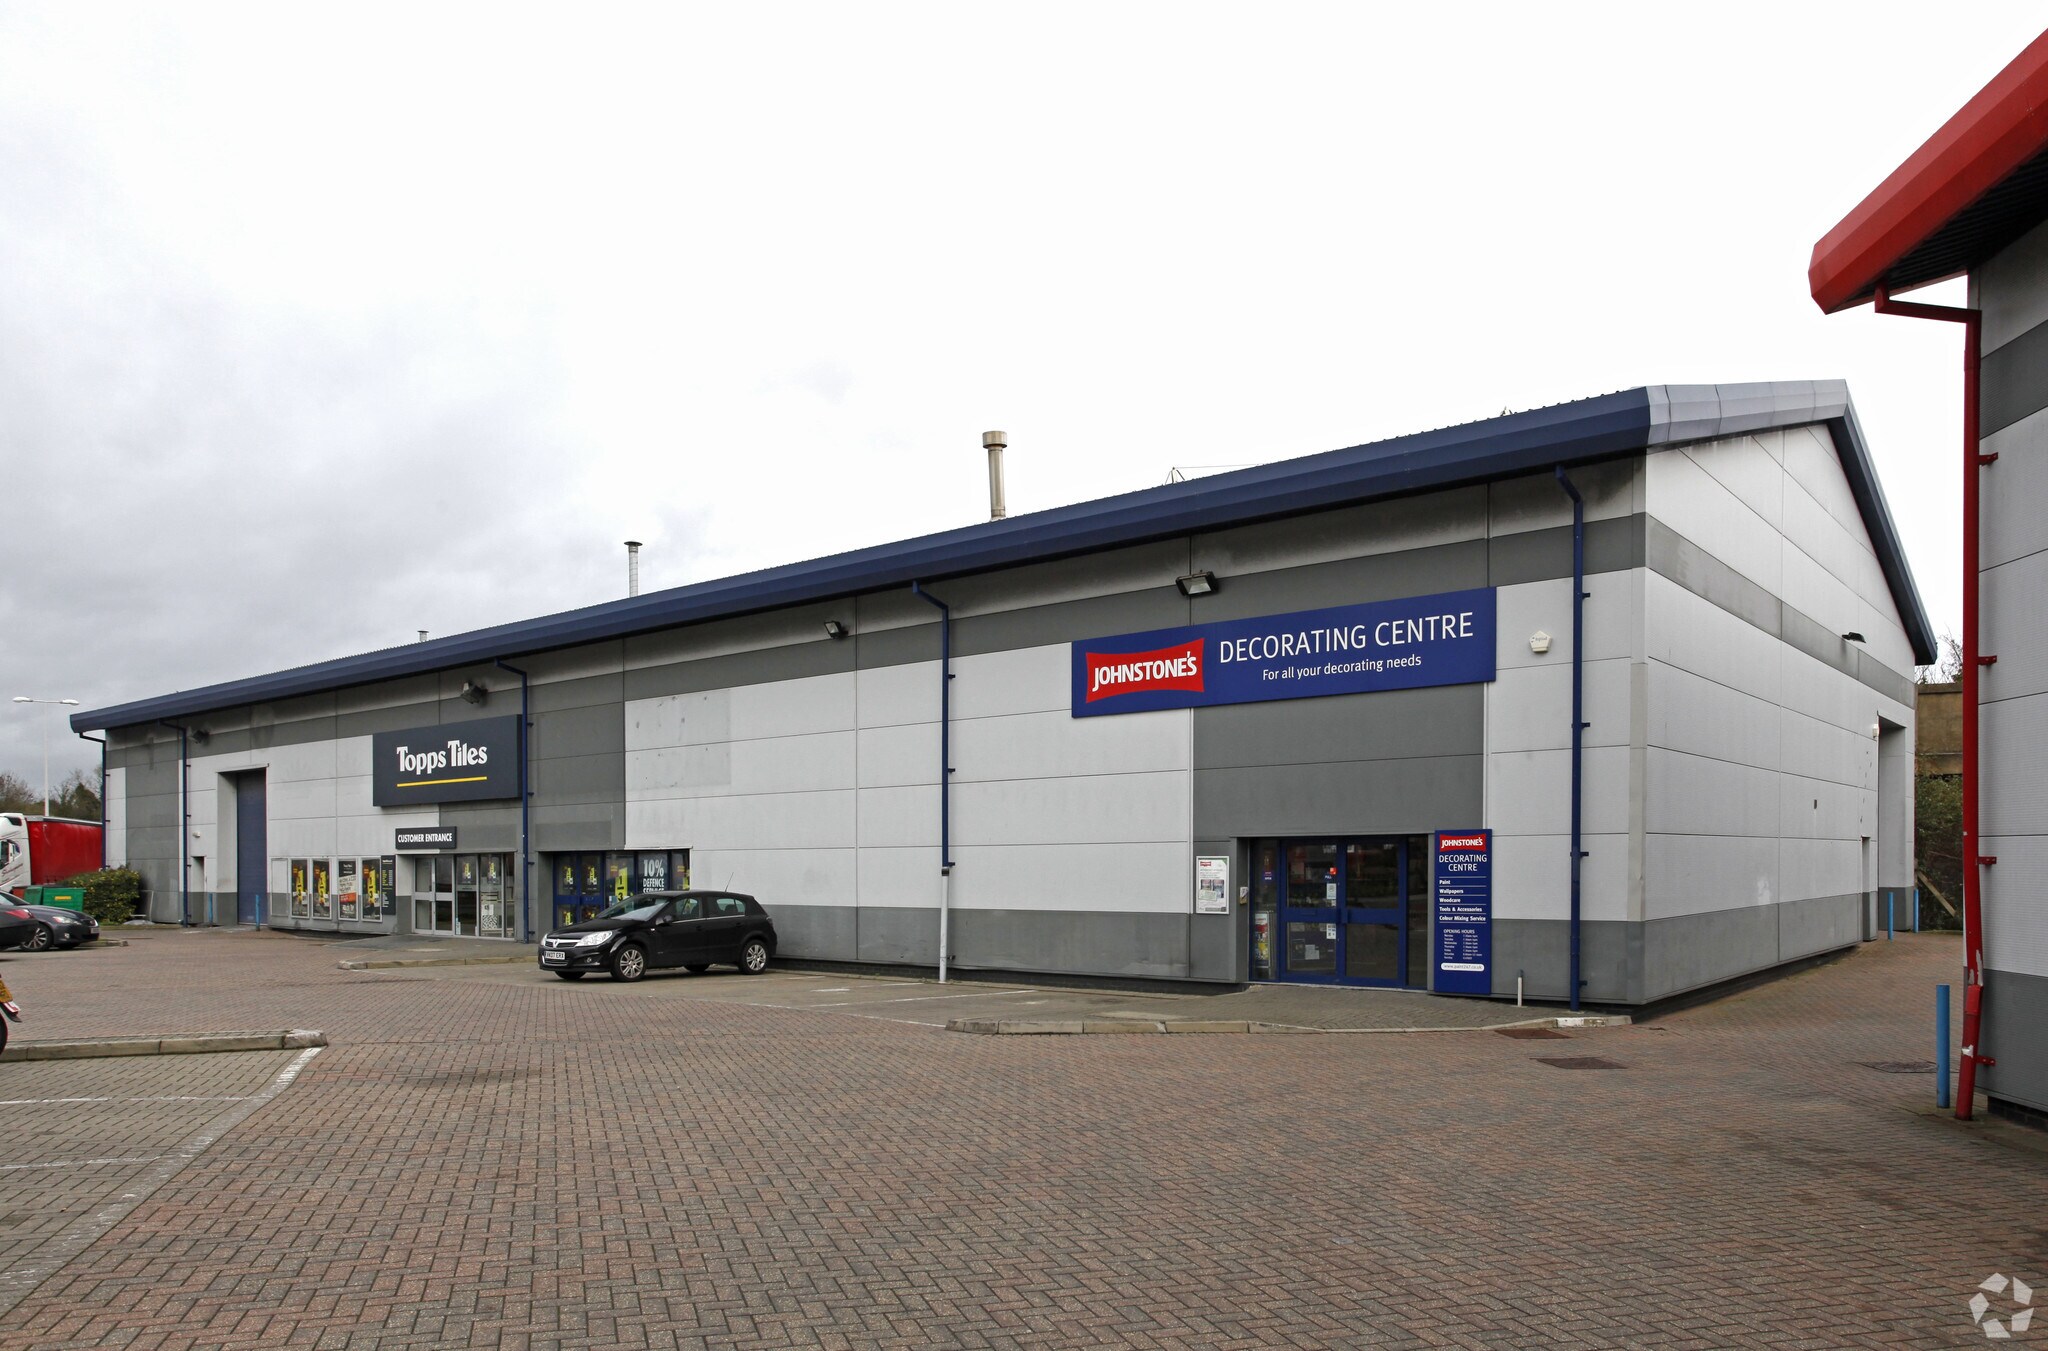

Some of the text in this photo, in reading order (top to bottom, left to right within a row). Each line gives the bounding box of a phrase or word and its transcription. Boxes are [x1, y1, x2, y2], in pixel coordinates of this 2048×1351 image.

[1220, 612, 1473, 663] DECORATING CENTRE
[1092, 651, 1198, 692] JOHNSTONE'S
[1263, 654, 1422, 681] For all your decorating needs
[396, 740, 488, 775] Topps Tiles
[397, 833, 453, 843] CUSTOMER ENTRANCE
[1440, 837, 1483, 849] JOHNSTONE'S
[1439, 854, 1487, 863] DECORATING
[643, 859, 665, 877] 10%
[1448, 863, 1478, 872] CENTRE
[643, 878, 665, 888] DEFENCE
